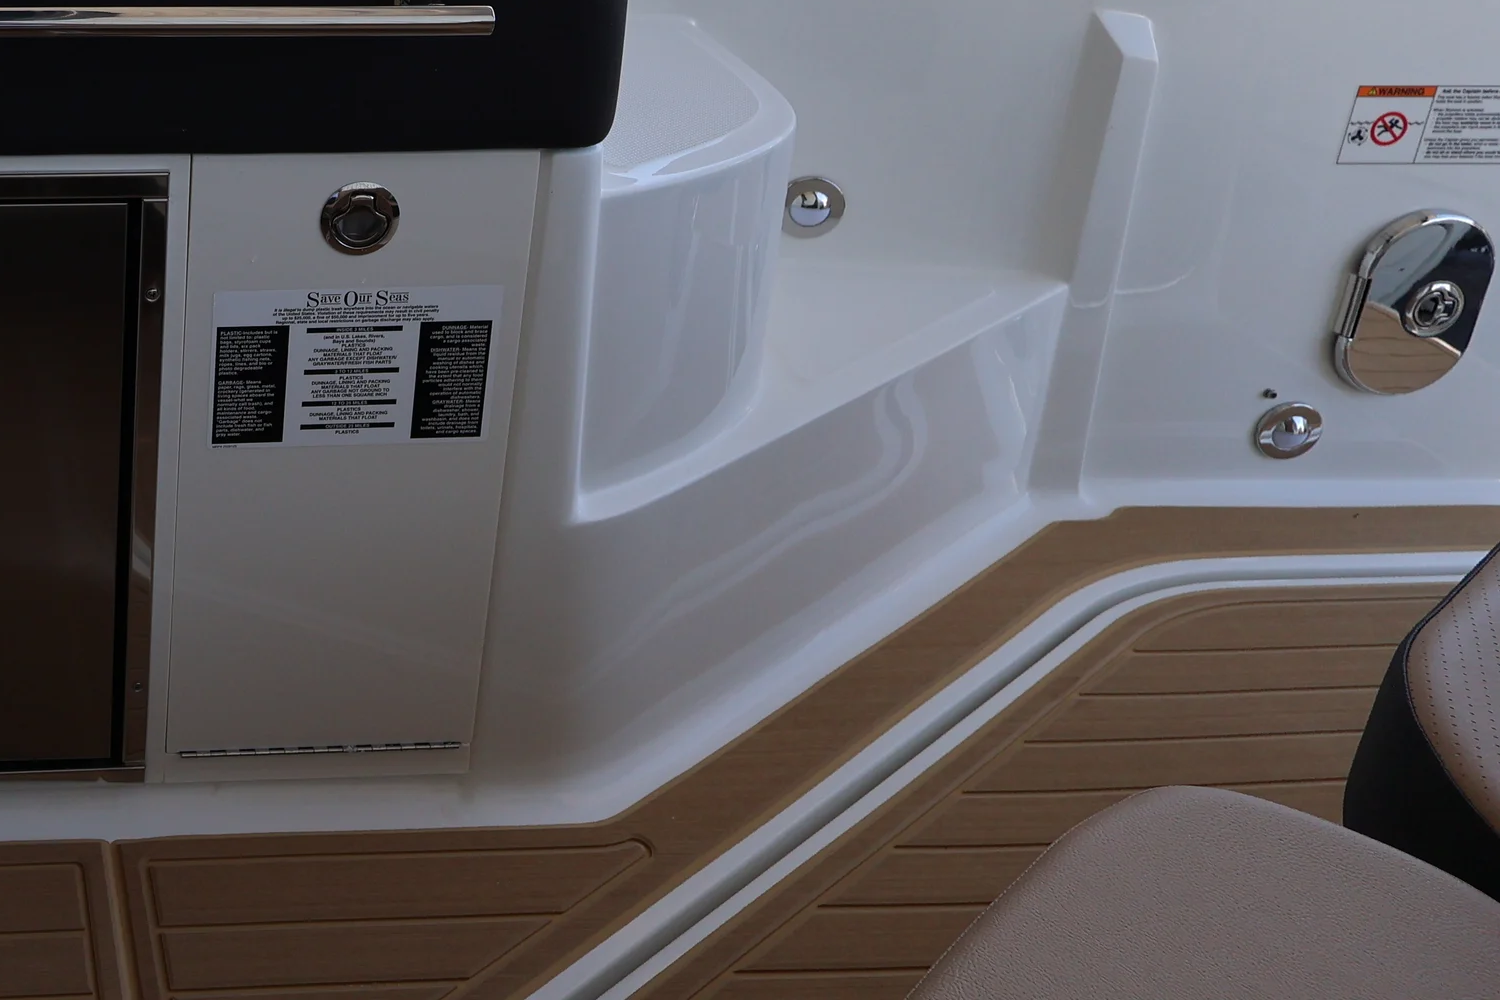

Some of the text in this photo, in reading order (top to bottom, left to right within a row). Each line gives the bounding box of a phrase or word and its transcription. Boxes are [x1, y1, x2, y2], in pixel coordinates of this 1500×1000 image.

[1378, 88, 1425, 96] WARNING
[307, 290, 409, 308] Save Our Seas
